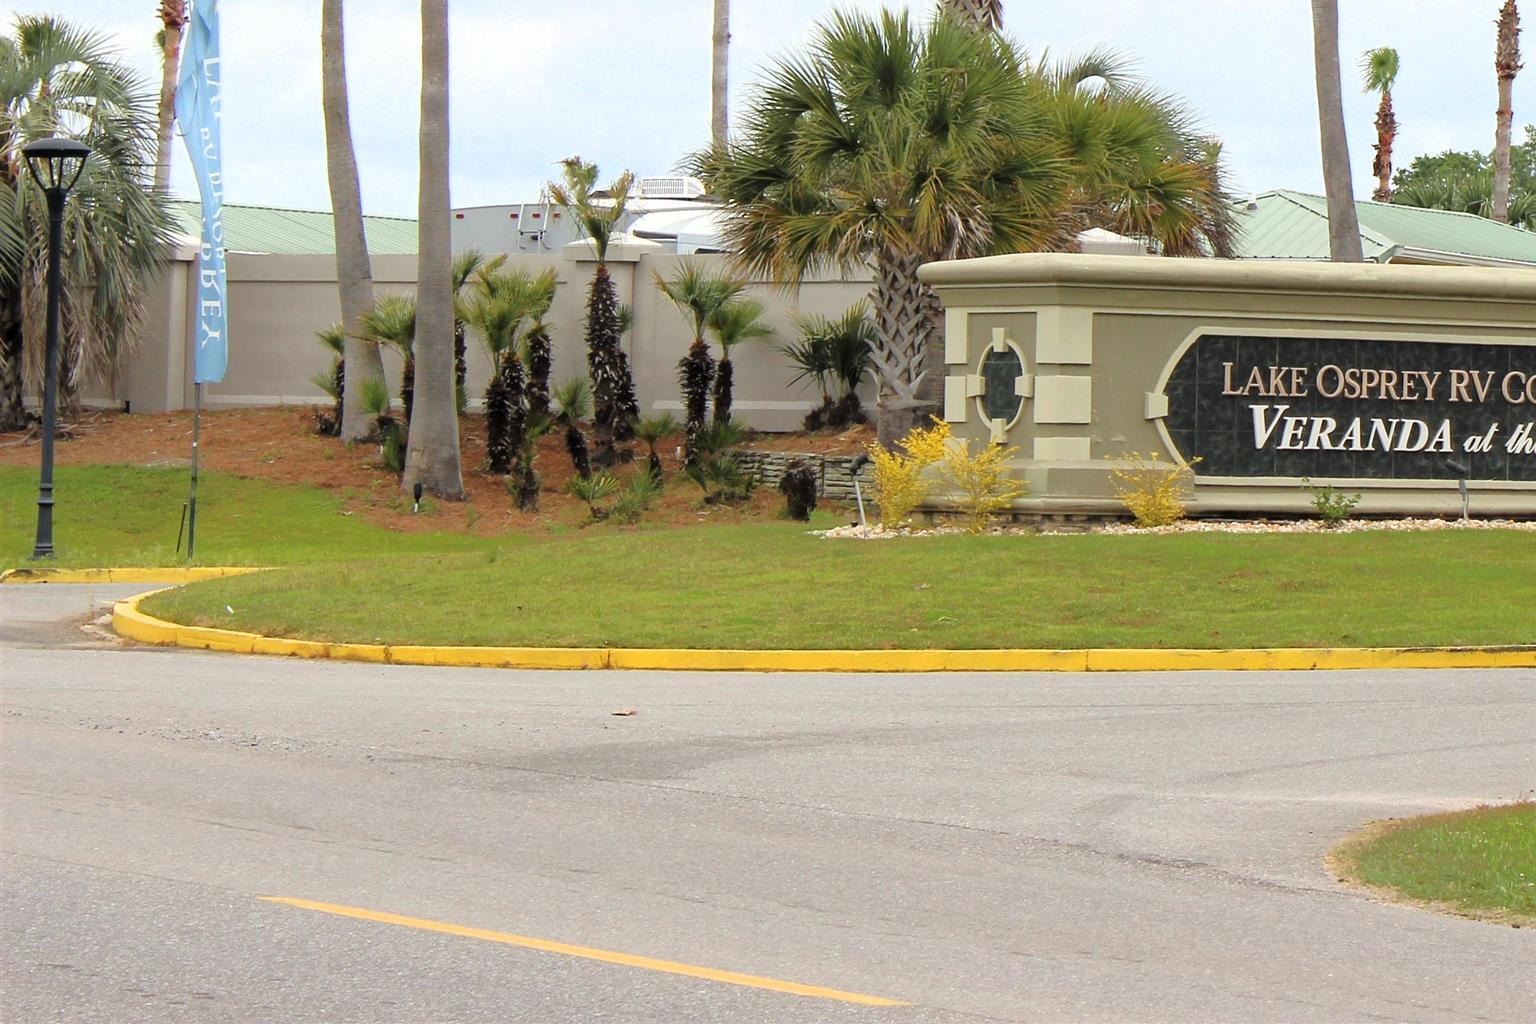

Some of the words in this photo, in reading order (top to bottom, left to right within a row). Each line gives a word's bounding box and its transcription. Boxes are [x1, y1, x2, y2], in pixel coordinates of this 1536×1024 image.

[1221, 362, 1308, 397] LAKE
[1316, 364, 1442, 401] OSPREY
[1449, 369, 1496, 404] RV
[1248, 404, 1455, 453] VERANDA
[1463, 420, 1499, 454] at
